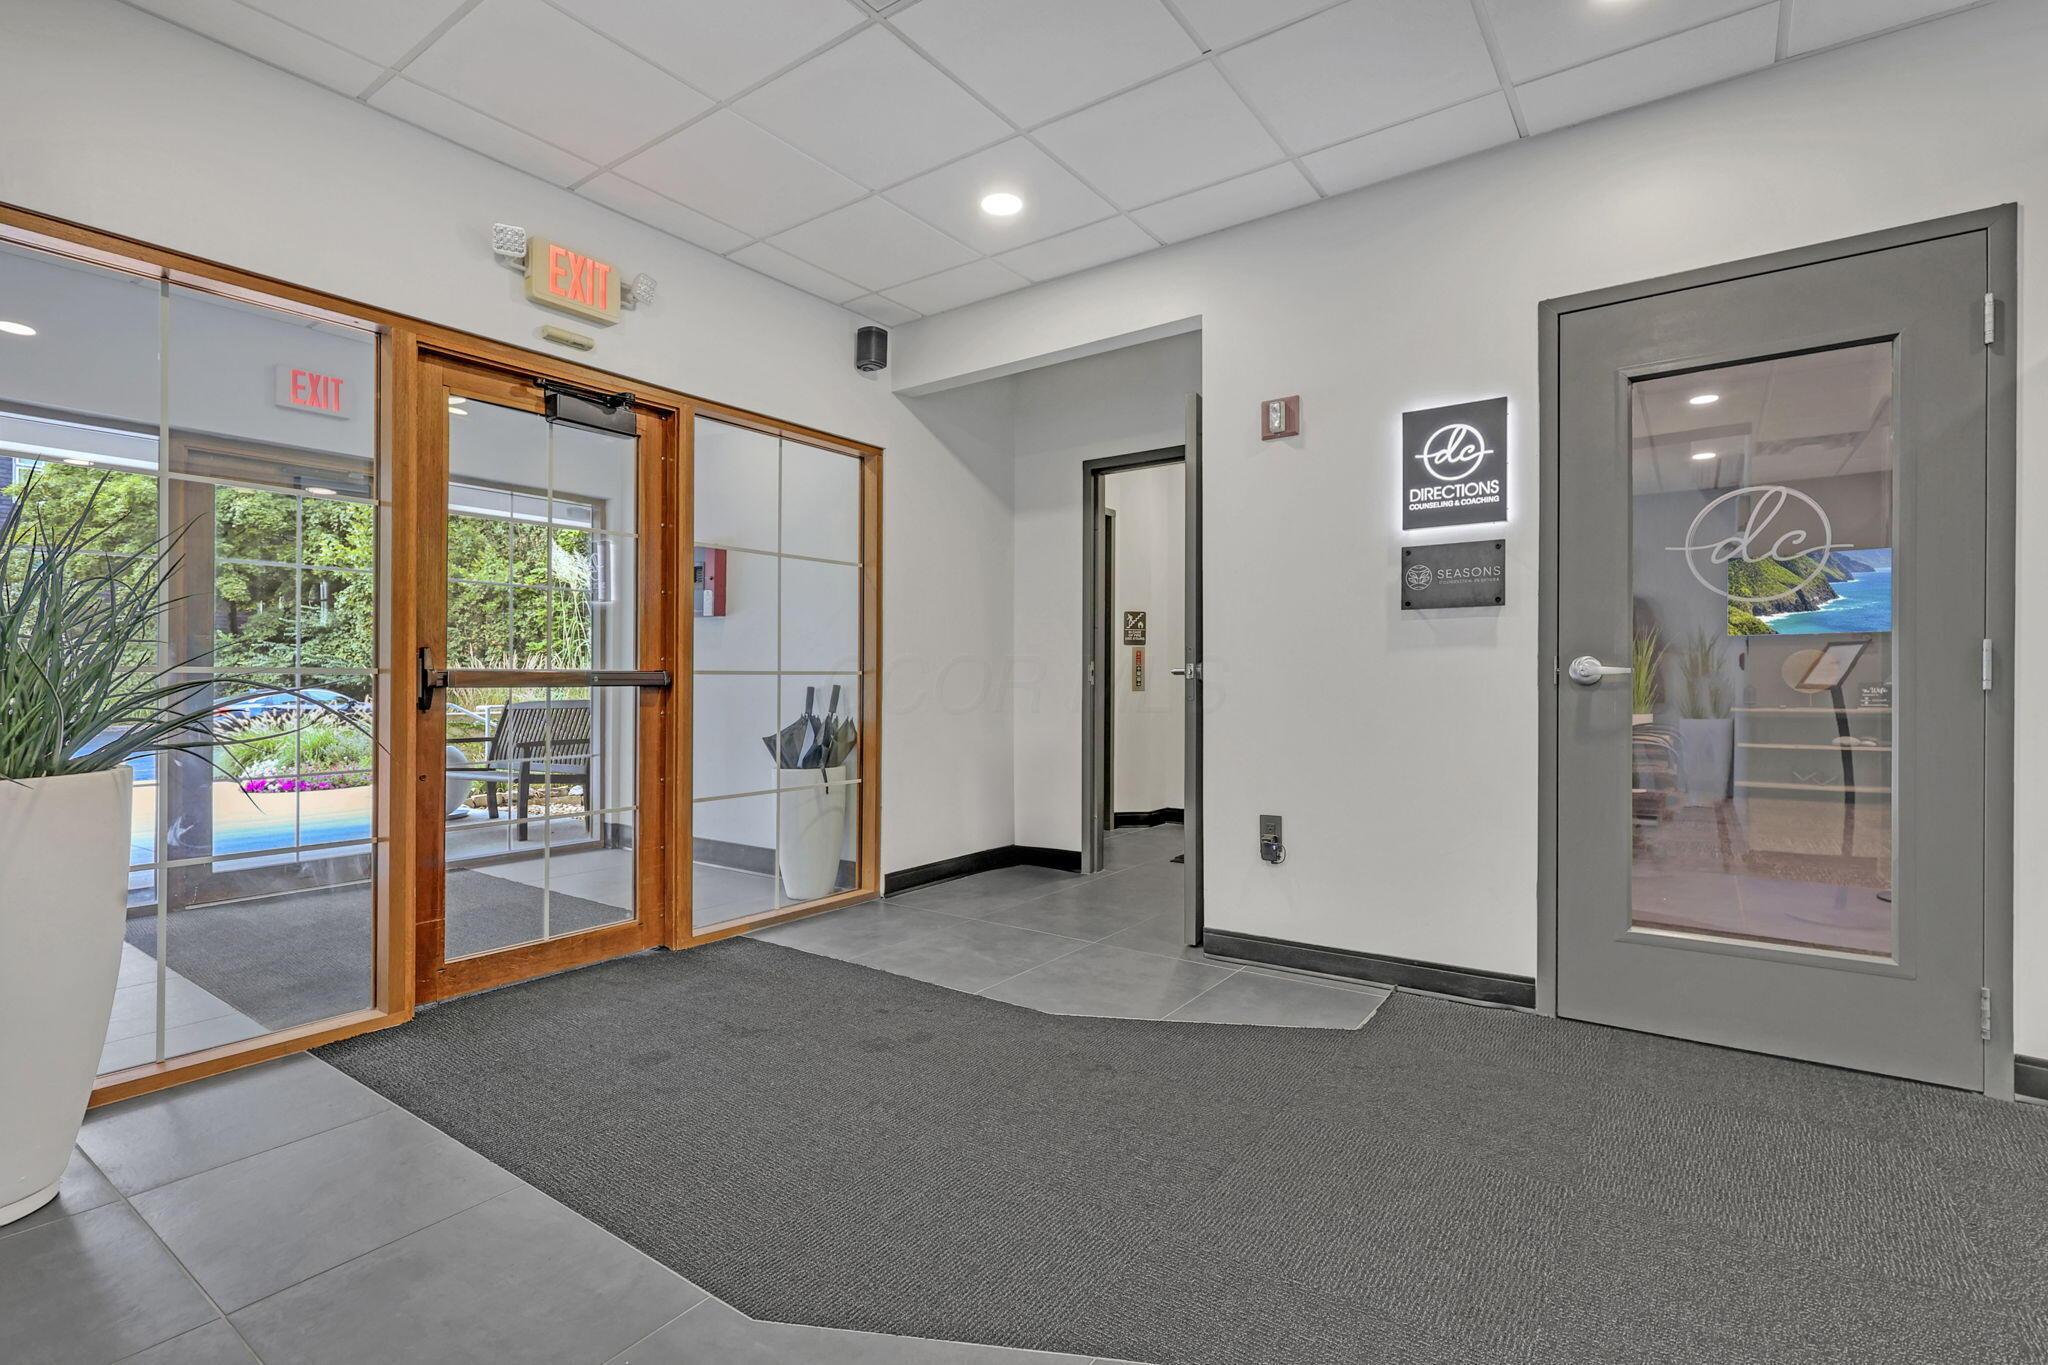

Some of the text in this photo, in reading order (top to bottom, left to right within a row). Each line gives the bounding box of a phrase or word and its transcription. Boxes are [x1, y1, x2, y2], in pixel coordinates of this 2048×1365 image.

[549, 243, 612, 312] EXIT
[290, 368, 344, 413] EXIT
[1409, 479, 1500, 502] DIRECTIONS
[1408, 500, 1454, 511] COUNSELING
[1460, 495, 1500, 506] COACHING
[1437, 565, 1501, 579] SEASONS
